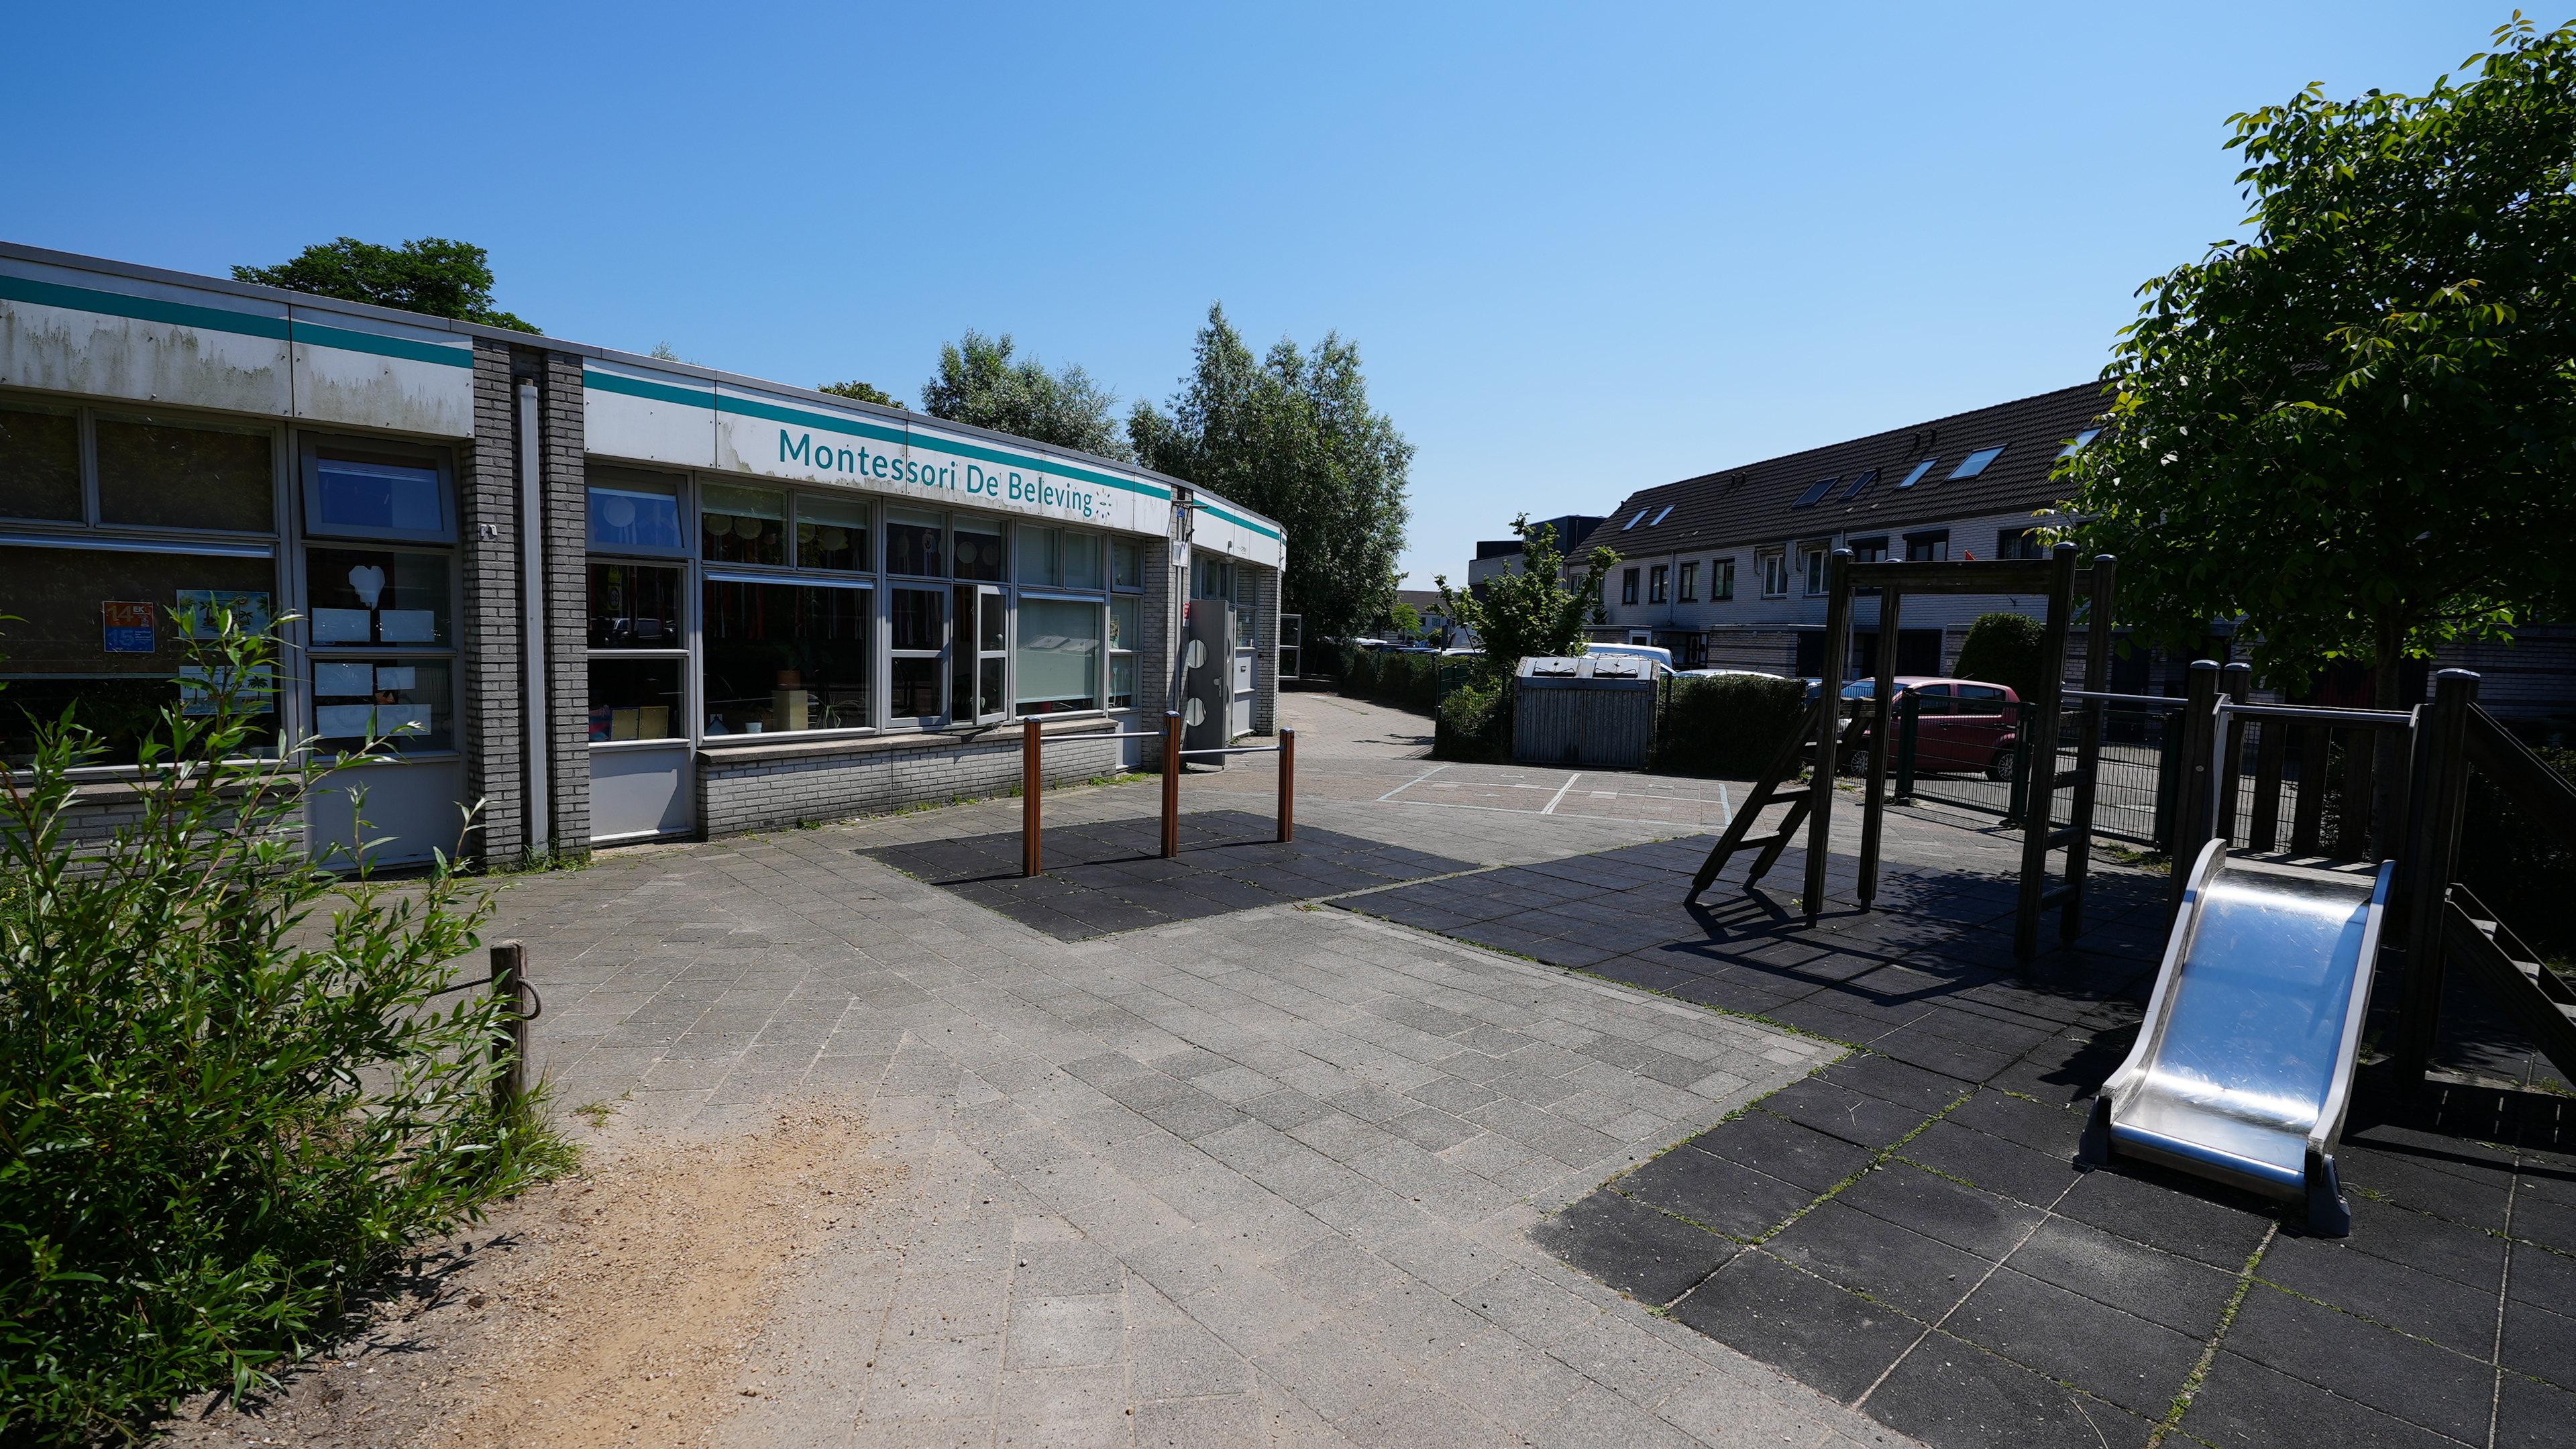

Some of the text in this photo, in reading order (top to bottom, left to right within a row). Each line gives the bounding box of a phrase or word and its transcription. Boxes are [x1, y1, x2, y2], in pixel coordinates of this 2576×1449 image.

[780, 429, 1093, 518] Montessori De Beleving
[107, 605, 134, 623] 14
[107, 629, 135, 647] 15
